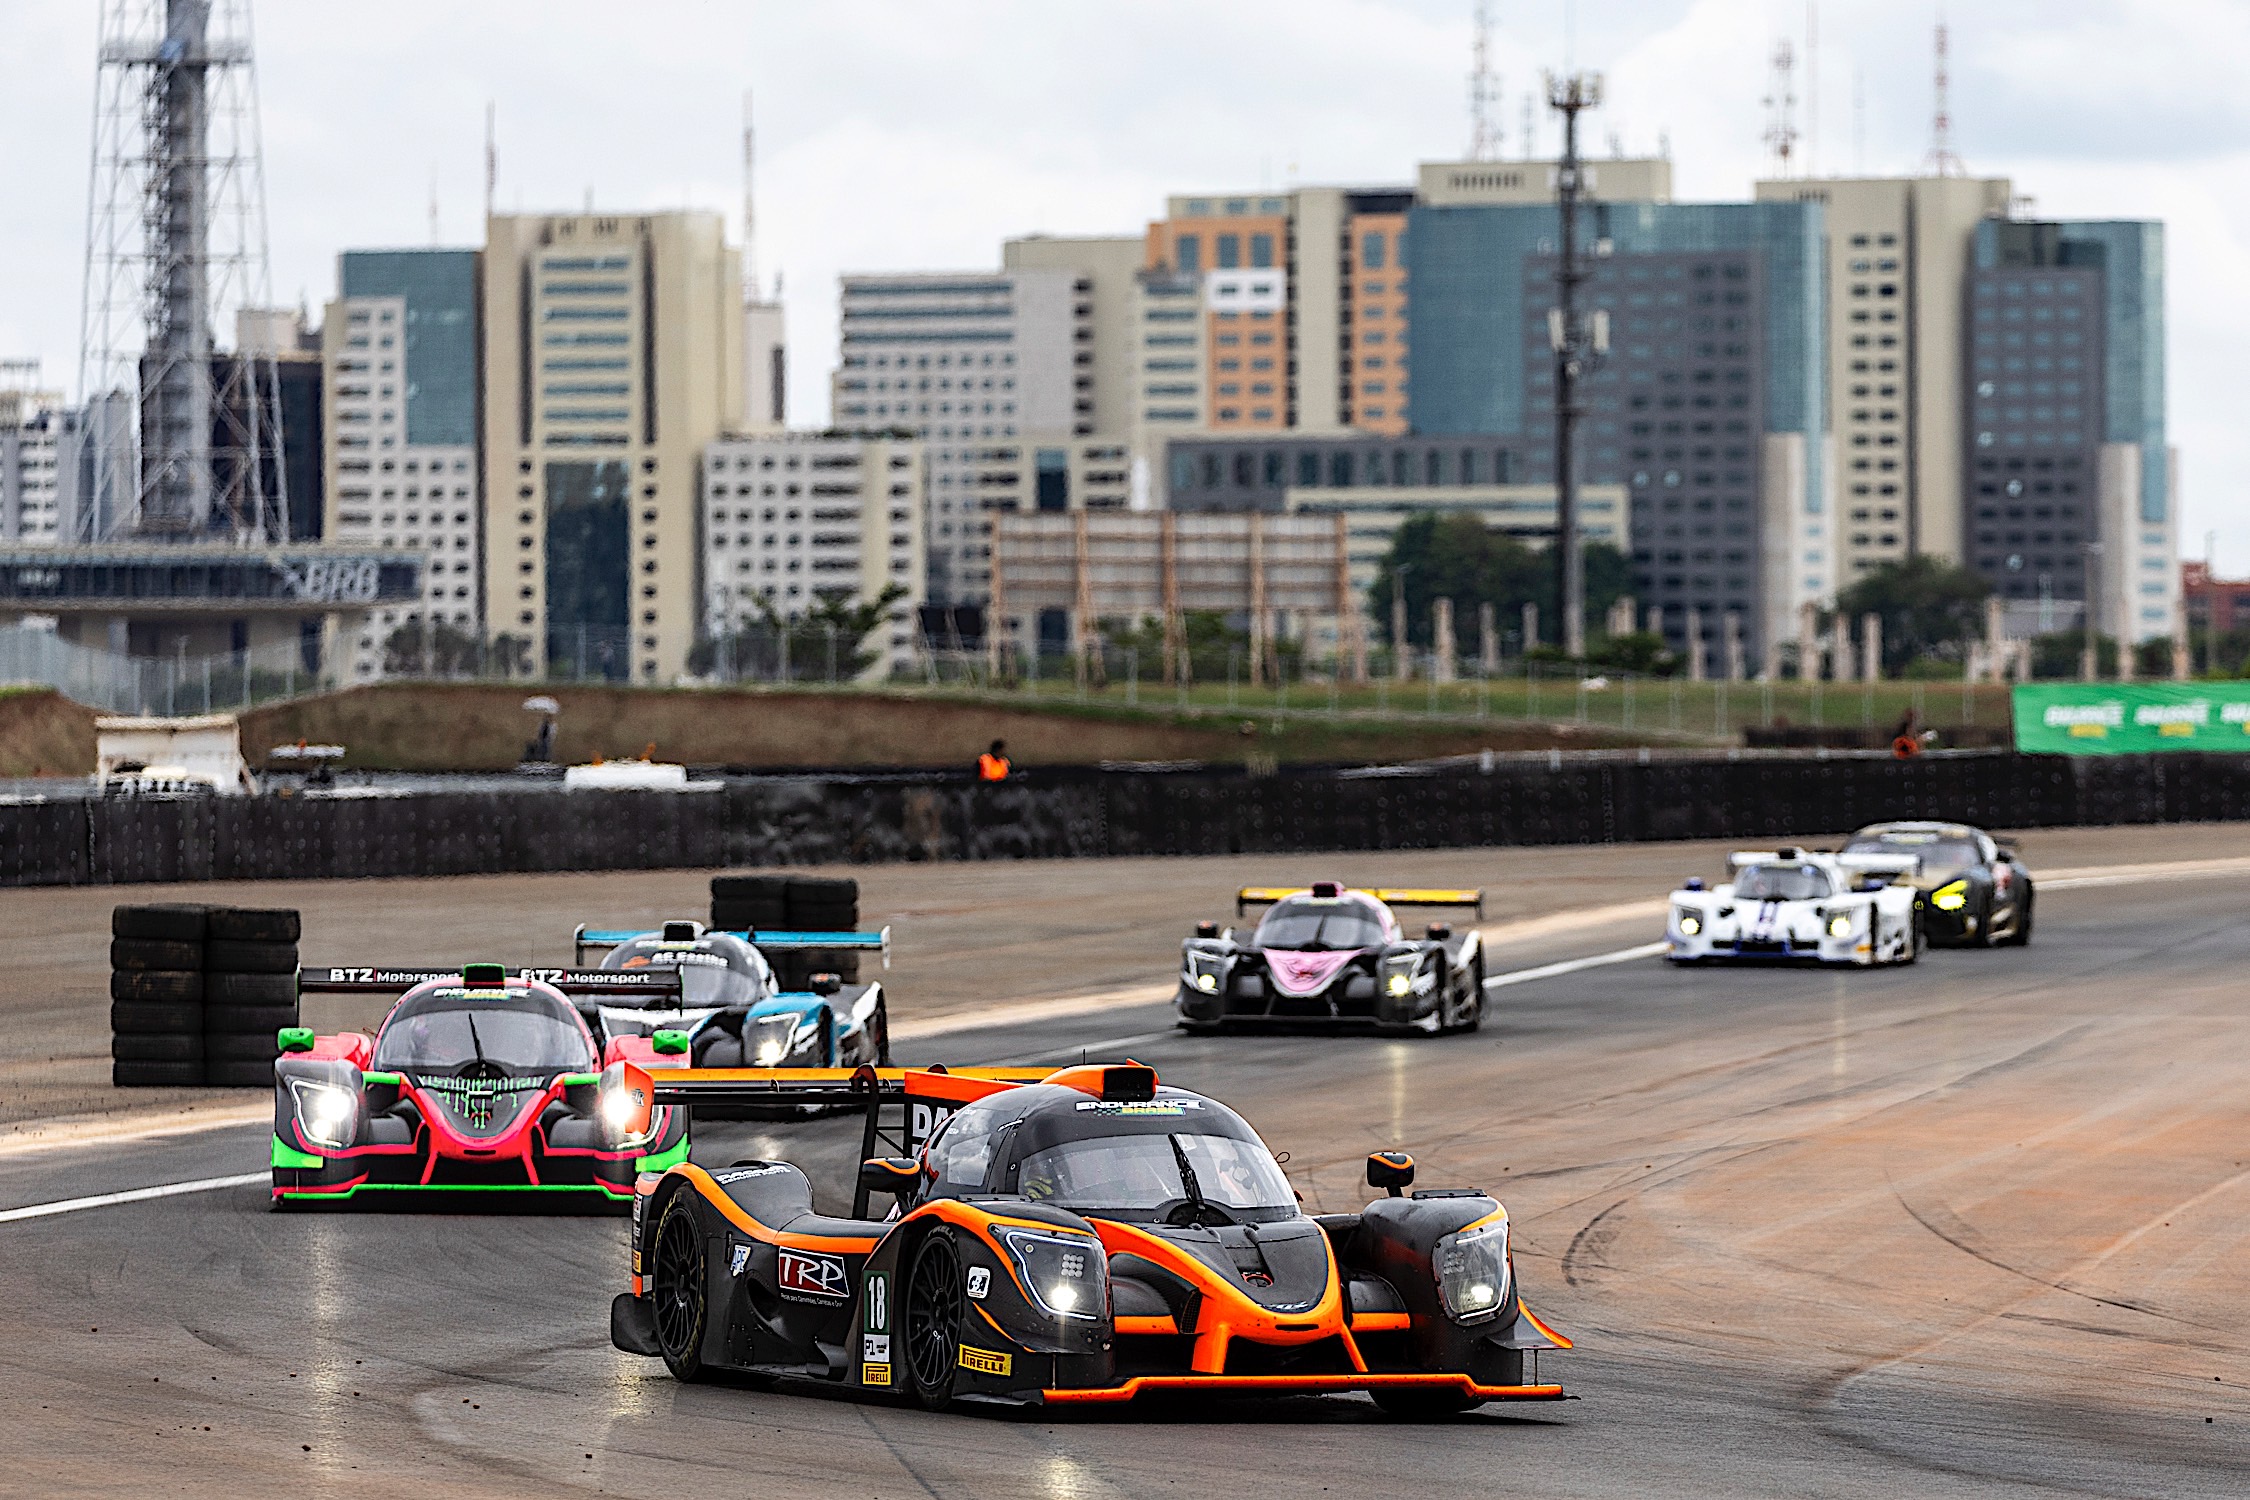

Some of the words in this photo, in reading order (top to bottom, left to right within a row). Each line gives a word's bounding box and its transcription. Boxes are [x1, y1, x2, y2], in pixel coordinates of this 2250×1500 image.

[330, 968, 374, 982] BTZ
[520, 968, 564, 983] BTZ
[566, 973, 650, 984] Motorsport
[1076, 1099, 1204, 1110] ENDURANCE
[779, 1252, 844, 1291] TRP
[868, 1276, 885, 1330] 18
[962, 1346, 1006, 1373] PIRELLI
[865, 1365, 888, 1383] PIRELLI
